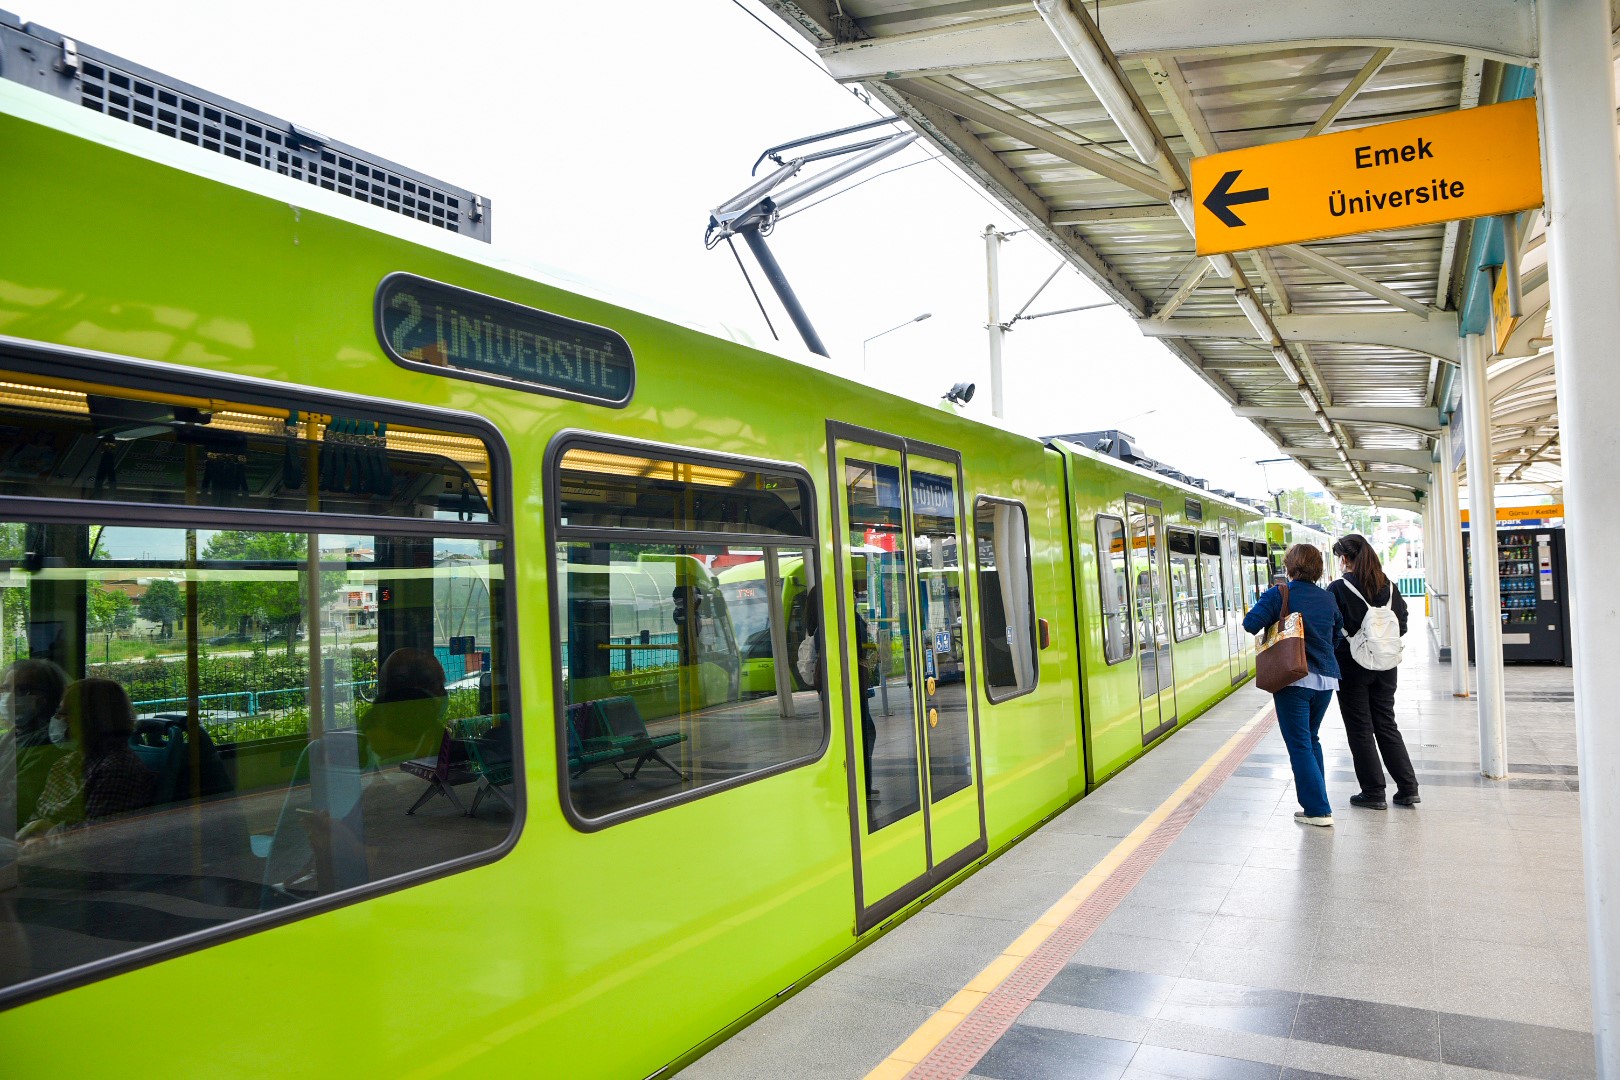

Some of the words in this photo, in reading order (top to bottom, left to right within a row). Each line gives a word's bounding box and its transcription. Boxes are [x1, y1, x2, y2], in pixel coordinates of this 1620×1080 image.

[1354, 138, 1434, 169] Emek
[1329, 178, 1465, 216] Üniversite
[392, 293, 422, 359] 2
